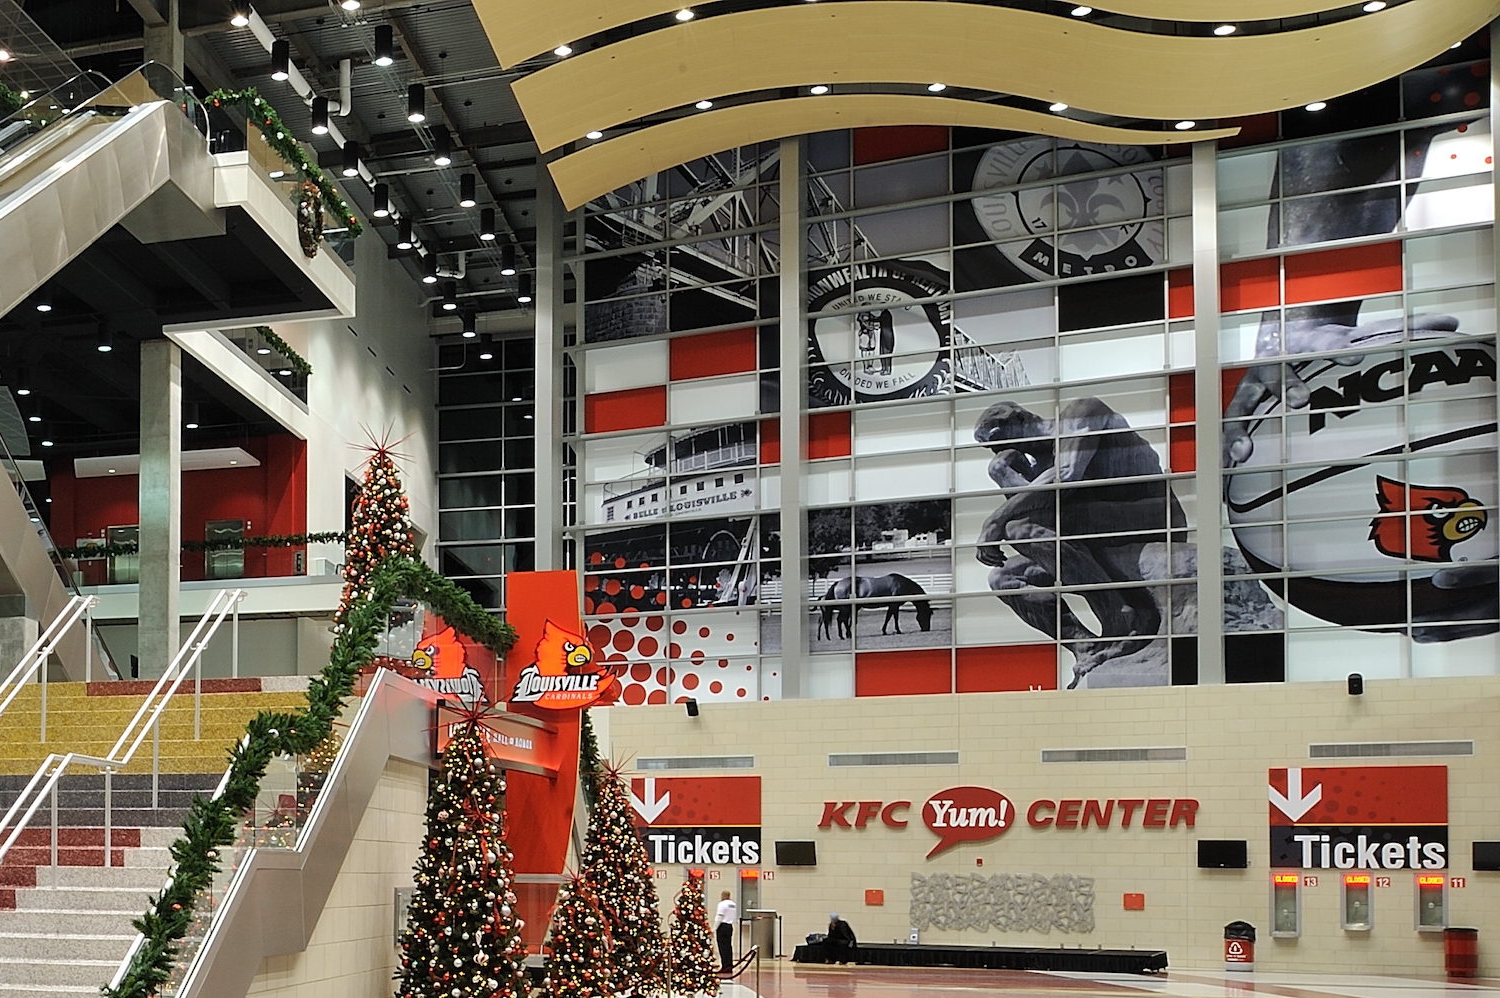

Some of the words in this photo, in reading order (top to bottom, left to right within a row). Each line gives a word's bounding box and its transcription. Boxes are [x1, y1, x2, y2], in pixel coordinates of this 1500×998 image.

[868, 293, 882, 301] WE
[875, 381, 889, 389] WE
[892, 372, 916, 386] FALL
[1309, 349, 1496, 435] NCAA
[633, 507, 659, 520] BELLE
[670, 490, 737, 513] LOUISVILLE
[512, 664, 600, 701] LOUISVILLE
[544, 692, 593, 700] CARDINALS
[817, 801, 911, 829] KFC
[928, 799, 1007, 828] Yum!
[1027, 799, 1200, 829] CENTER
[648, 834, 760, 865] Tickets
[1293, 835, 1446, 869] Tickets
[710, 871, 720, 880] 15
[764, 872, 774, 880] 14
[1304, 877, 1317, 887] 13
[1376, 878, 1390, 888] 12
[1451, 878, 1464, 888] 11
